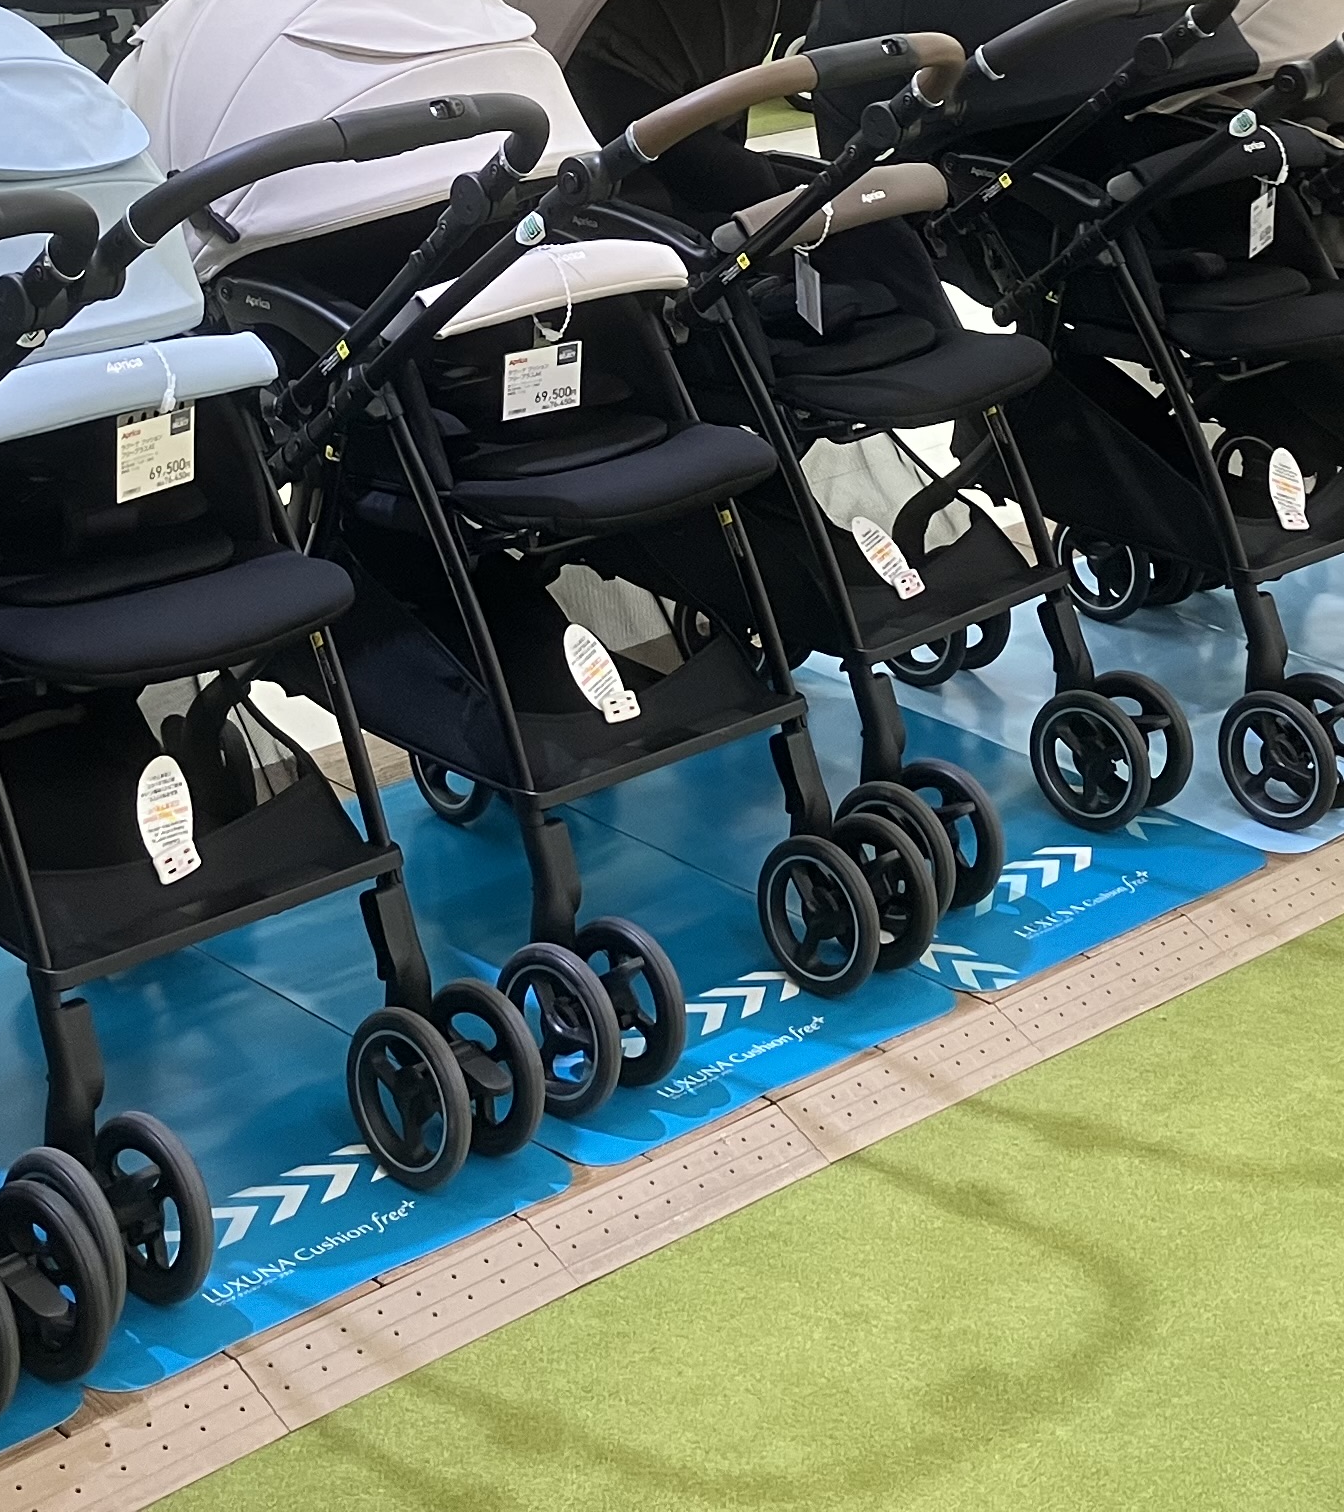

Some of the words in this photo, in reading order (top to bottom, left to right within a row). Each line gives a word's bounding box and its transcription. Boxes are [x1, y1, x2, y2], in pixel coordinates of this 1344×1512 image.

[571, 215, 599, 229] Aprica
[245, 294, 271, 310] Aprica
[106, 356, 144, 374] Aprica
[1013, 904, 1086, 939] LUXUNA
[656, 1059, 734, 1099] LUXUNA
[728, 1032, 794, 1063] Cushion
[201, 1258, 297, 1306] LUXUNA
[294, 1222, 374, 1262] Cushion
